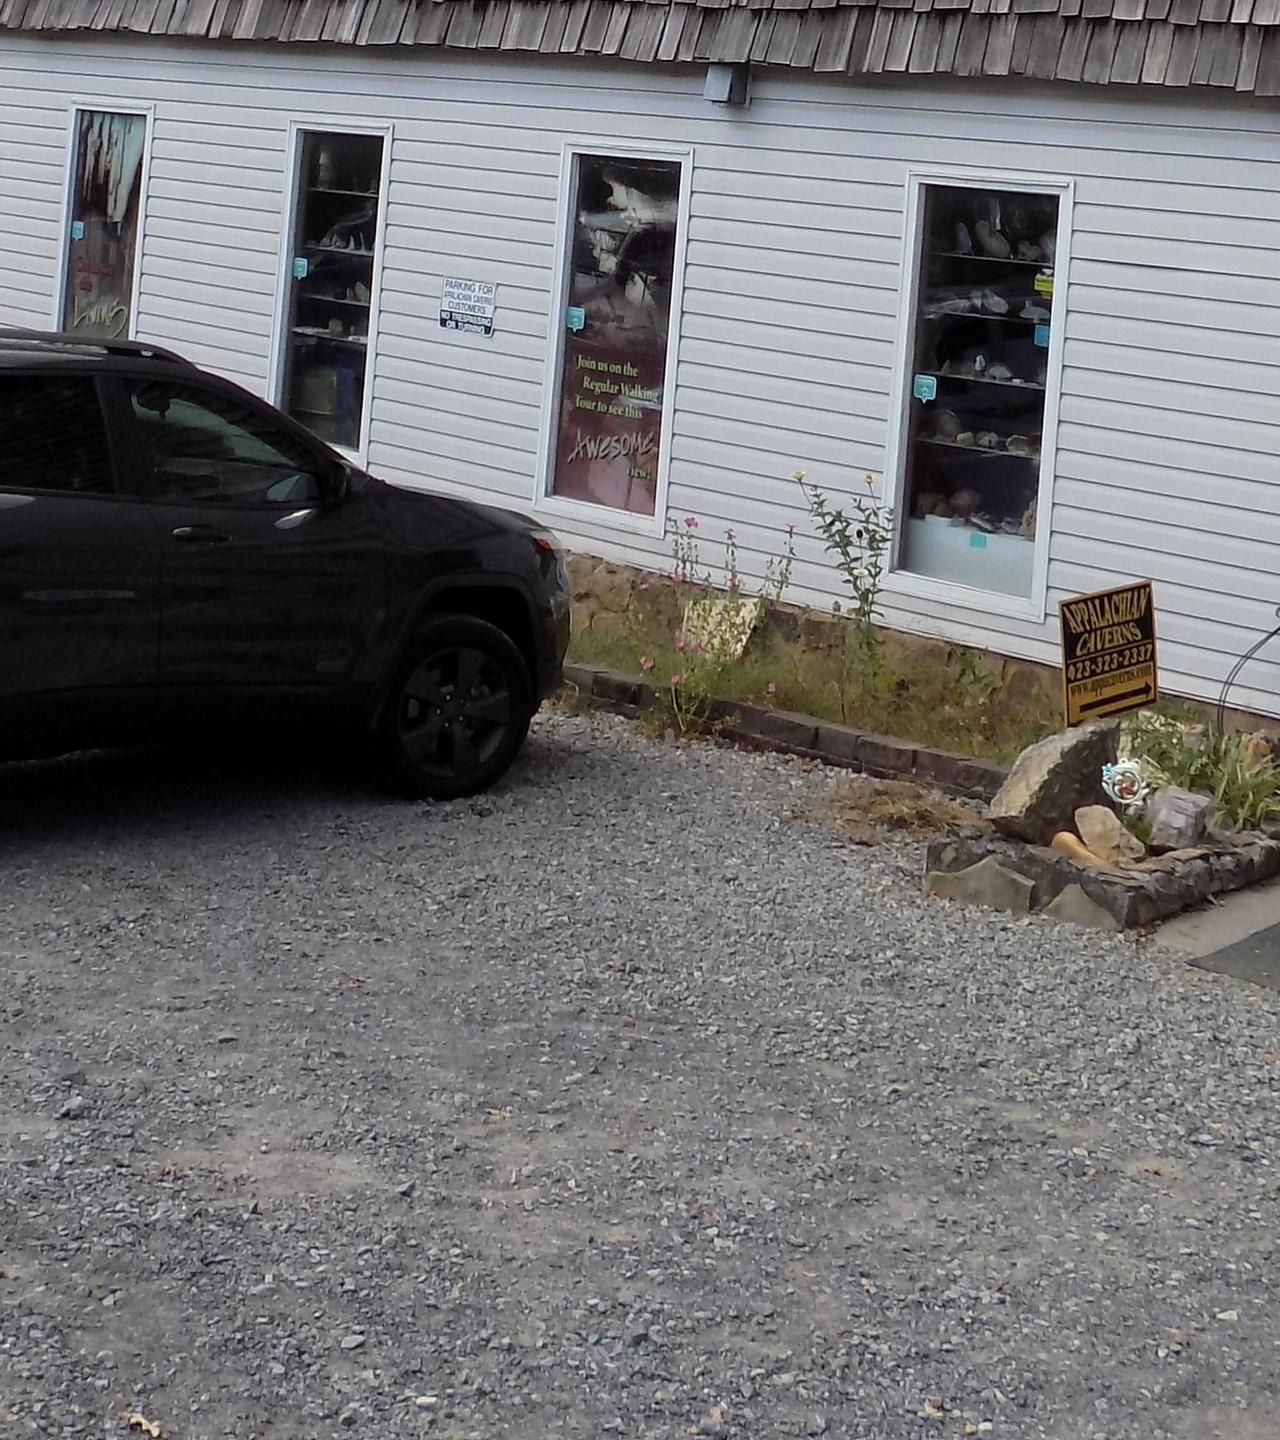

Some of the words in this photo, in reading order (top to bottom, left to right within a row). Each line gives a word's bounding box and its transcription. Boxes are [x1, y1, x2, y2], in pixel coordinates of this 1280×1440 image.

[445, 279, 476, 293] PARKING
[478, 284, 494, 296] FOR
[448, 300, 486, 314] CUSTOMERS
[576, 355, 596, 370] Join
[597, 361, 608, 372] us
[609, 364, 622, 375] on
[623, 362, 639, 377] the
[583, 375, 620, 396] Regular
[619, 382, 659, 404] Walking
[575, 394, 597, 410] Tour
[597, 401, 607, 412] to
[608, 404, 624, 416] see
[625, 404, 643, 419] this
[1063, 587, 1150, 634] APPALACHIAN
[1075, 621, 1142, 657] CAVERNS
